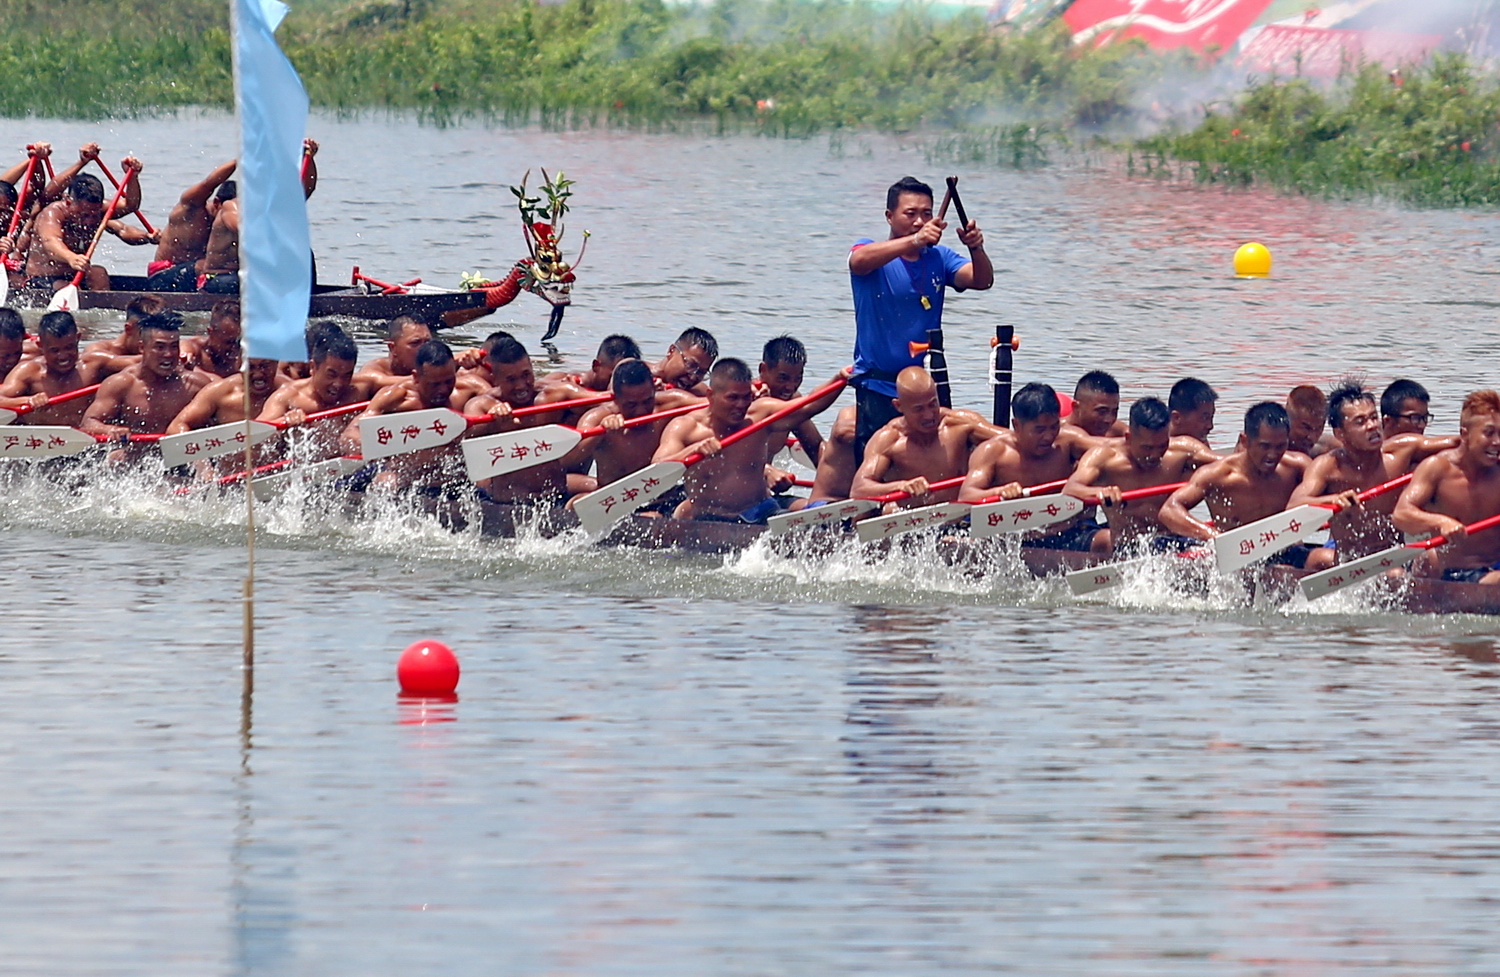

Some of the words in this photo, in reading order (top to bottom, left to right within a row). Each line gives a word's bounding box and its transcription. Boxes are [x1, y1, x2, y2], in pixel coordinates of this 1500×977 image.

[4, 434, 65, 451] 龙舟队
[184, 431, 246, 455] 中东西
[377, 419, 448, 446] 中東西
[486, 439, 551, 467] 龙舟队
[599, 477, 660, 514] 龙舟队
[987, 503, 1060, 526] 中東西
[1240, 520, 1302, 555] 中东西
